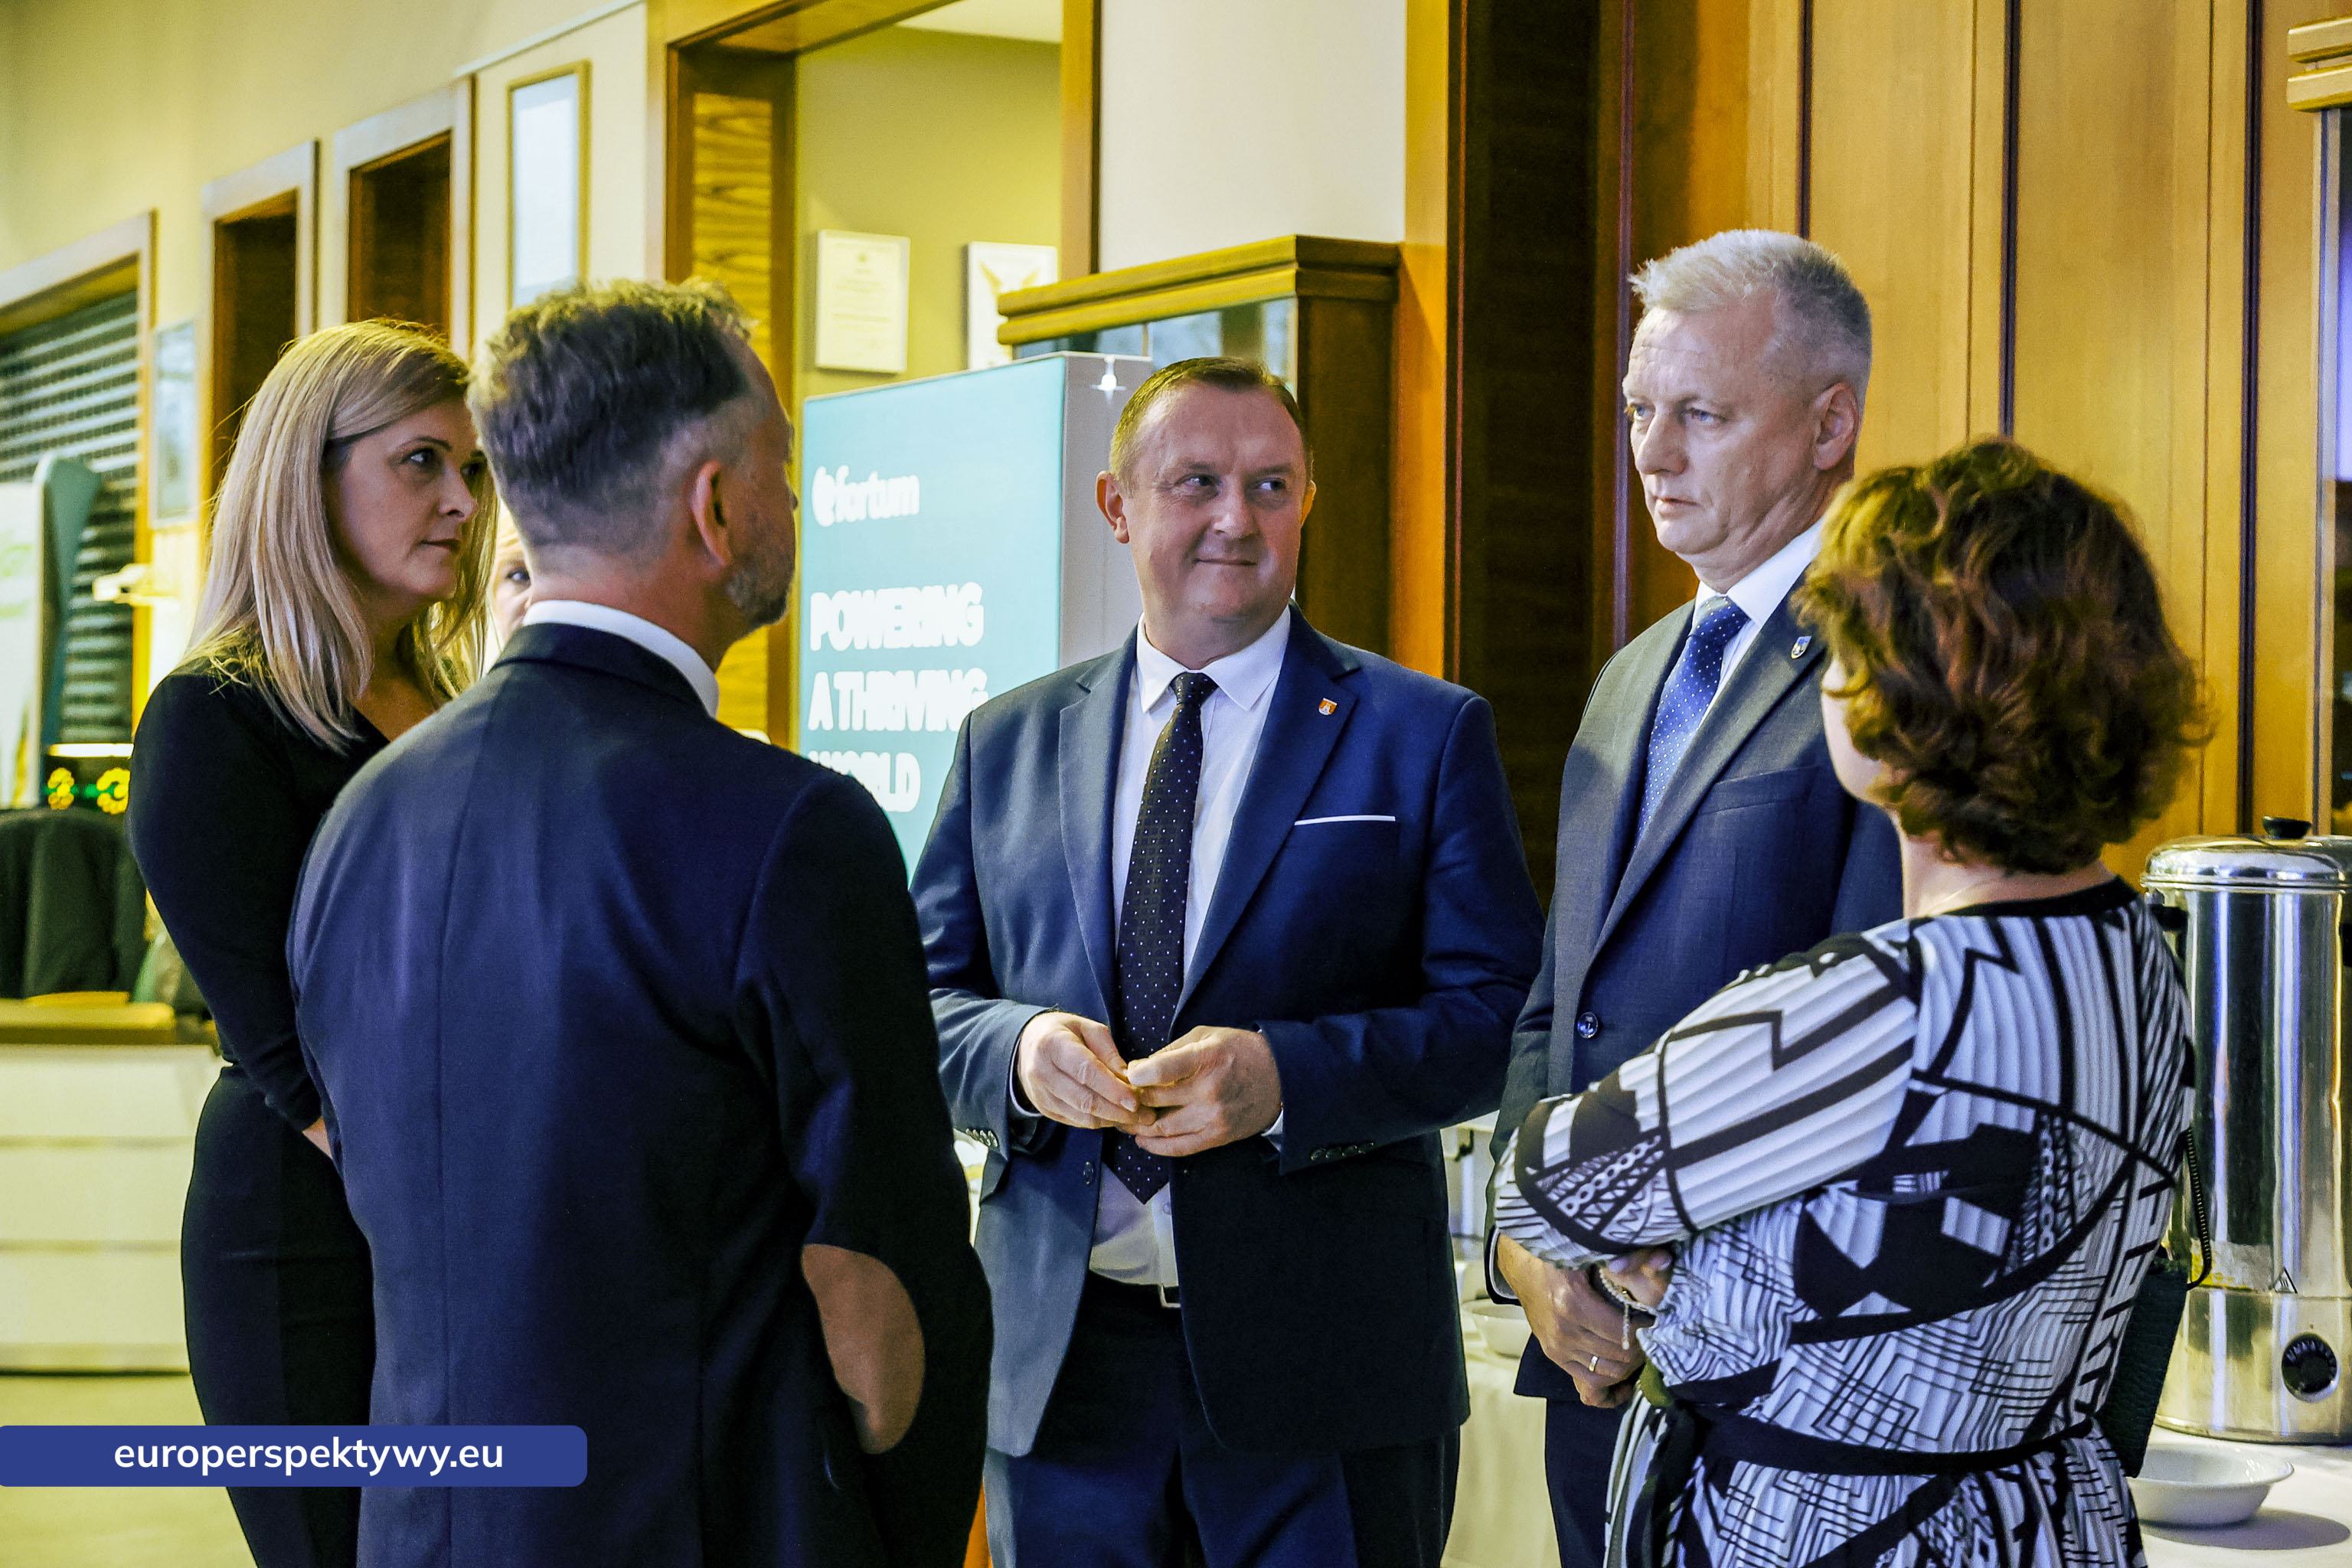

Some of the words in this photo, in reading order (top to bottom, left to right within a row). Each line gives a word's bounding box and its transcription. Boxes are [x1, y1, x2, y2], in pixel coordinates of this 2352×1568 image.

[835, 465, 920, 523] fortum
[810, 582, 984, 651] POWERING
[808, 671, 834, 730] A
[834, 668, 988, 732] THRIVING
[808, 750, 921, 812] RLD
